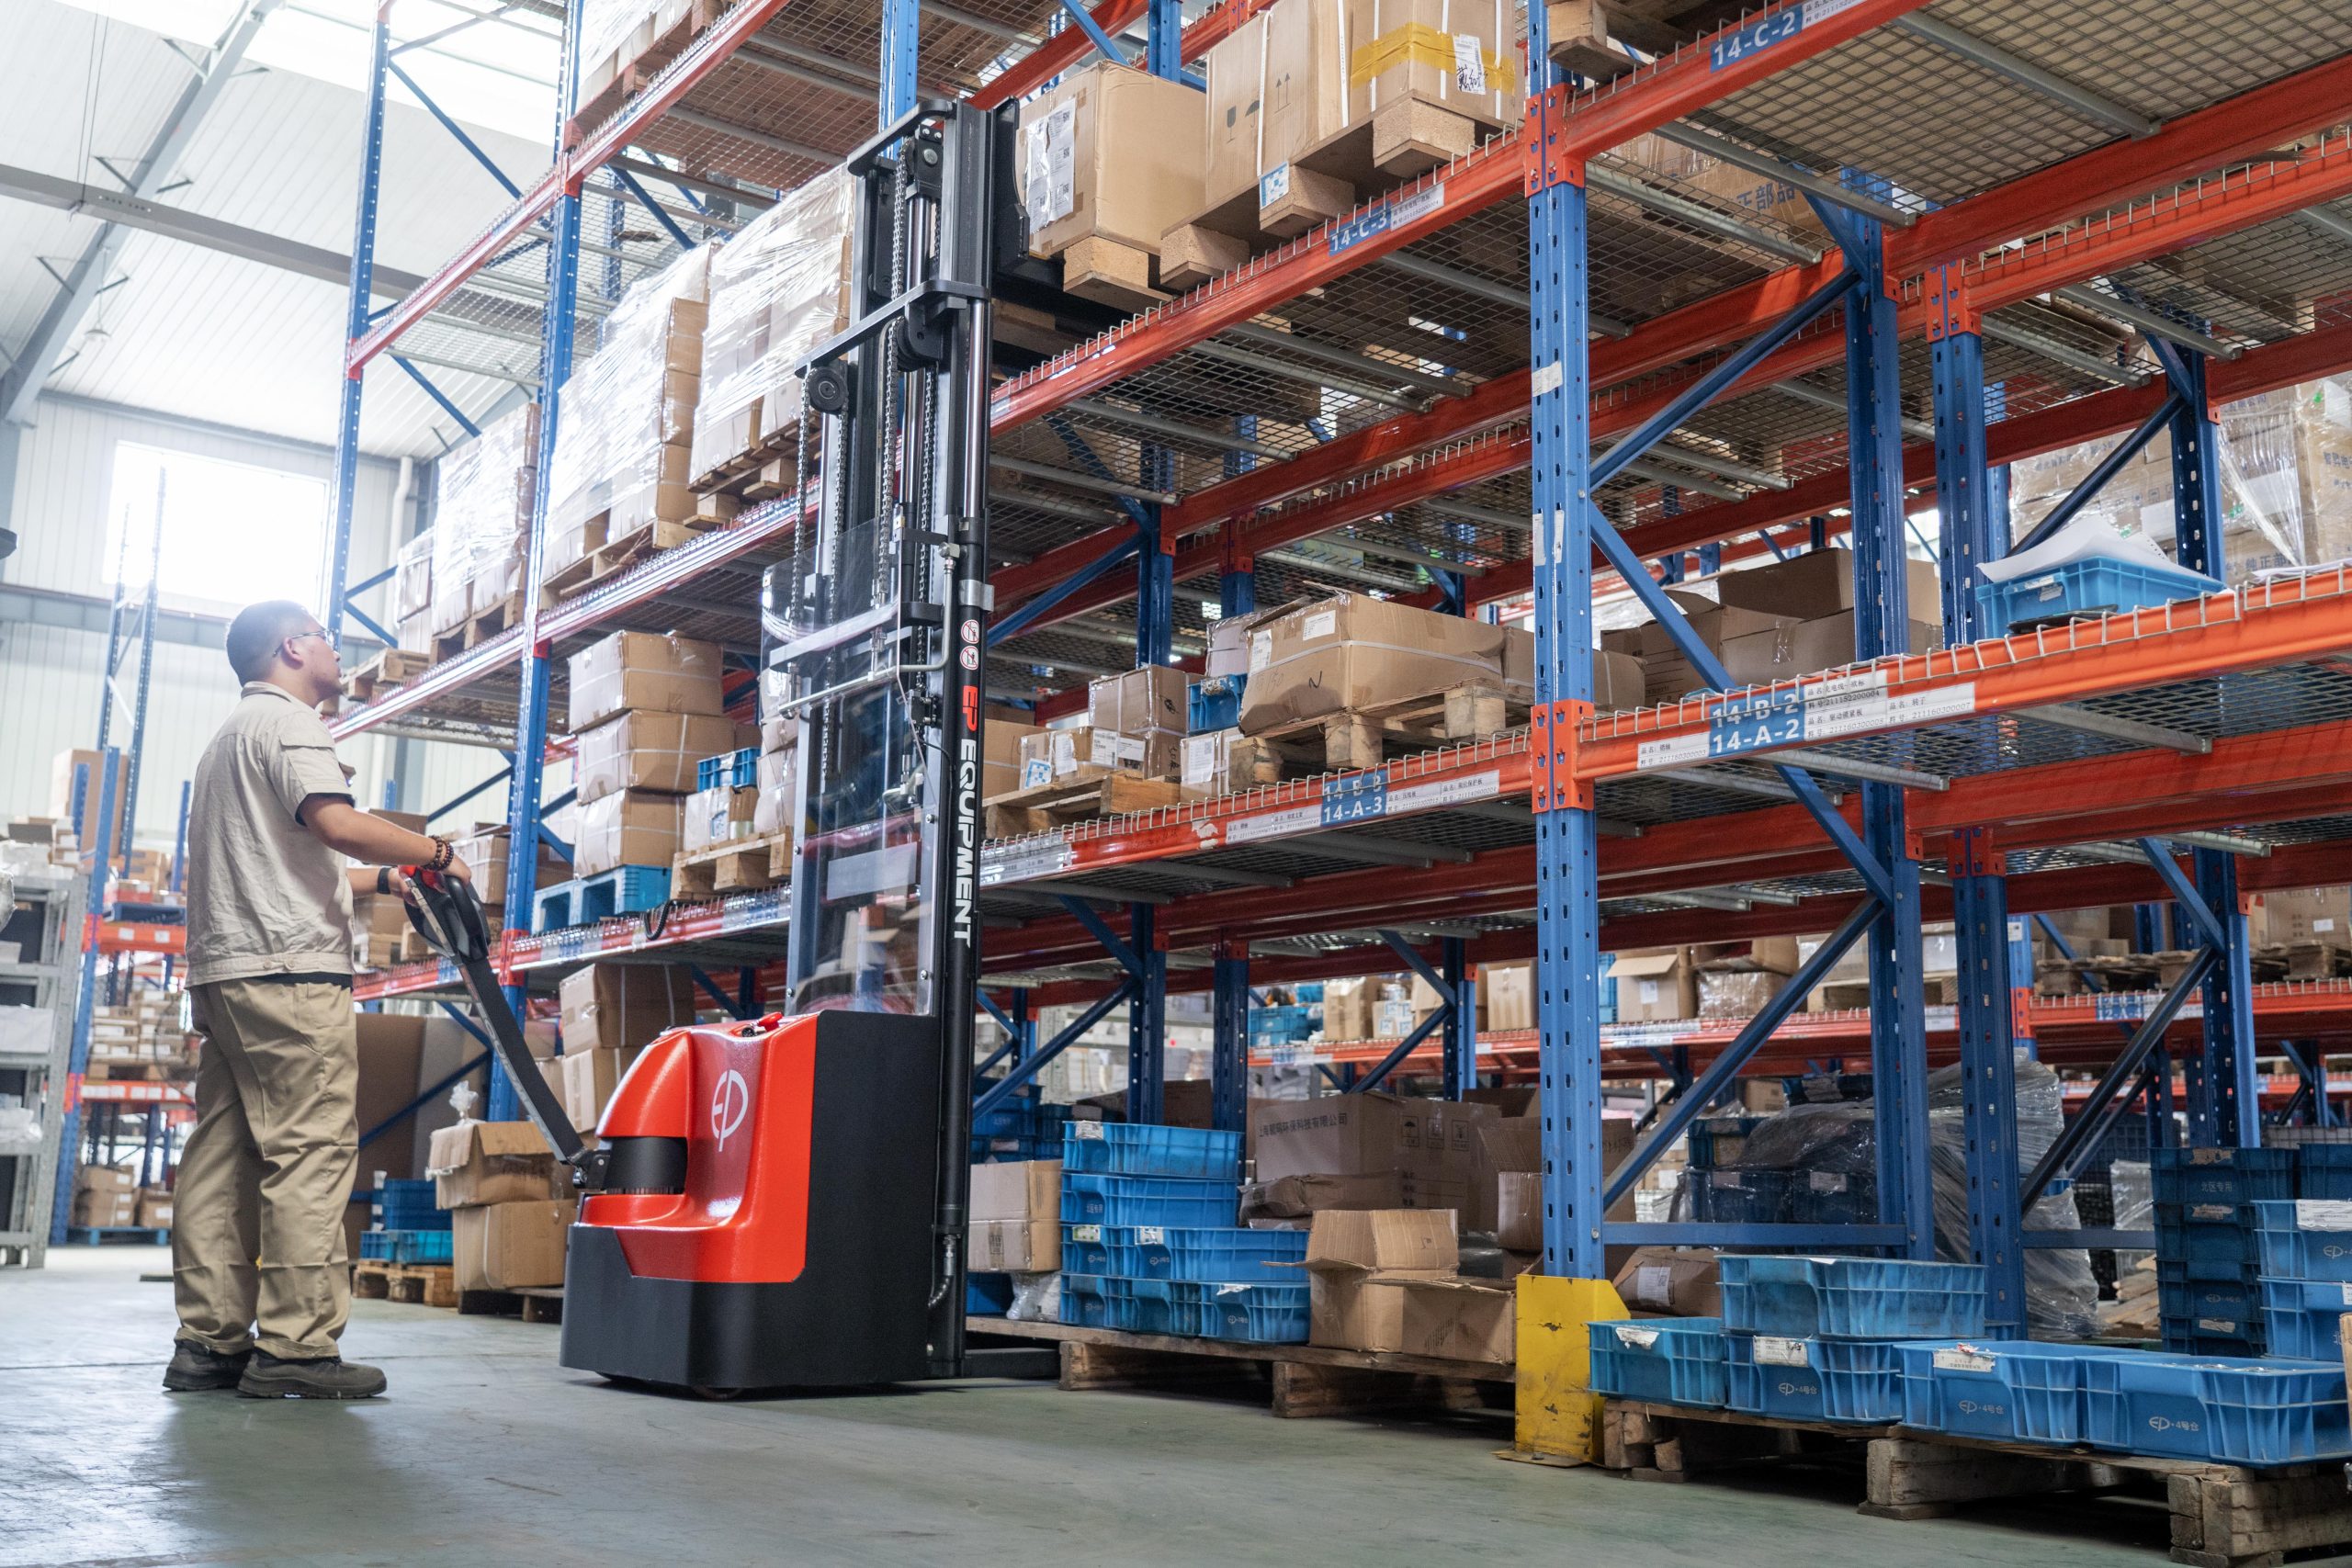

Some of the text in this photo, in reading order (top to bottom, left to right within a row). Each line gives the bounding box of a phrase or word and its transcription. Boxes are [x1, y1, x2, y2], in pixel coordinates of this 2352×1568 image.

[1714, 11, 1796, 66] 14-C-2
[1332, 211, 1387, 252] 14-C-3
[1713, 693, 1799, 728] 14-B-2
[1713, 718, 1800, 754] 14-A-2
[1324, 775, 1382, 802] 14B3
[954, 685, 978, 949] EP EQUIPMENT
[1324, 796, 1383, 823] 14-A-3
[2200, 1181, 2233, 1192] 北区专用
